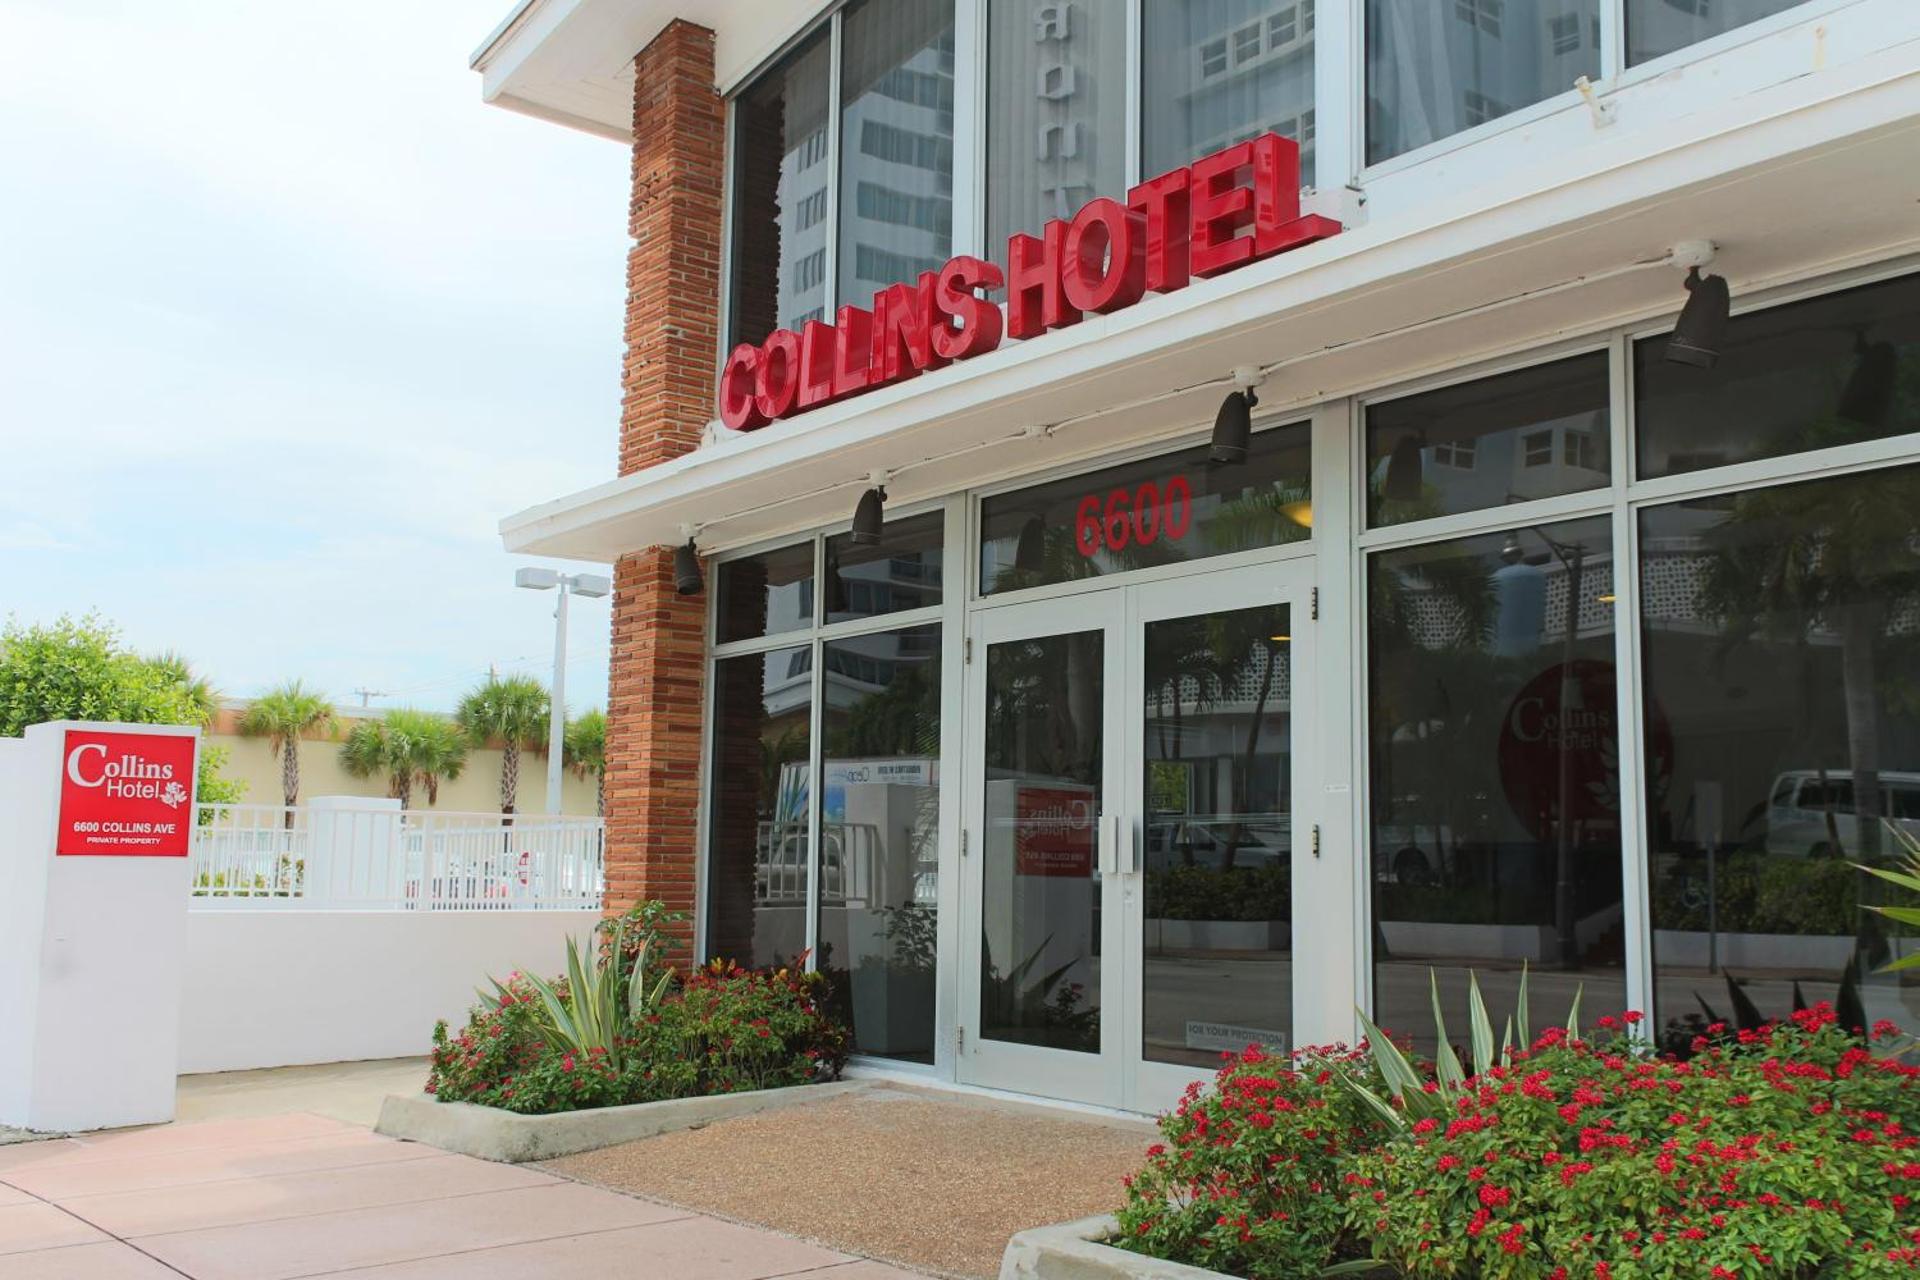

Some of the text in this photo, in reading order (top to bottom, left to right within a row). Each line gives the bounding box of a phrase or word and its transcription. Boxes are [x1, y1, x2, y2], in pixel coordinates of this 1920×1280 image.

[719, 132, 1343, 431] COLLINS HOTEL
[1075, 474, 1192, 558] 6600
[67, 743, 173, 787] Collins
[106, 778, 160, 798] Hotel
[73, 821, 176, 834] 6600 COLLINS AVE
[86, 836, 161, 845] PRIVATE PROPERTY
